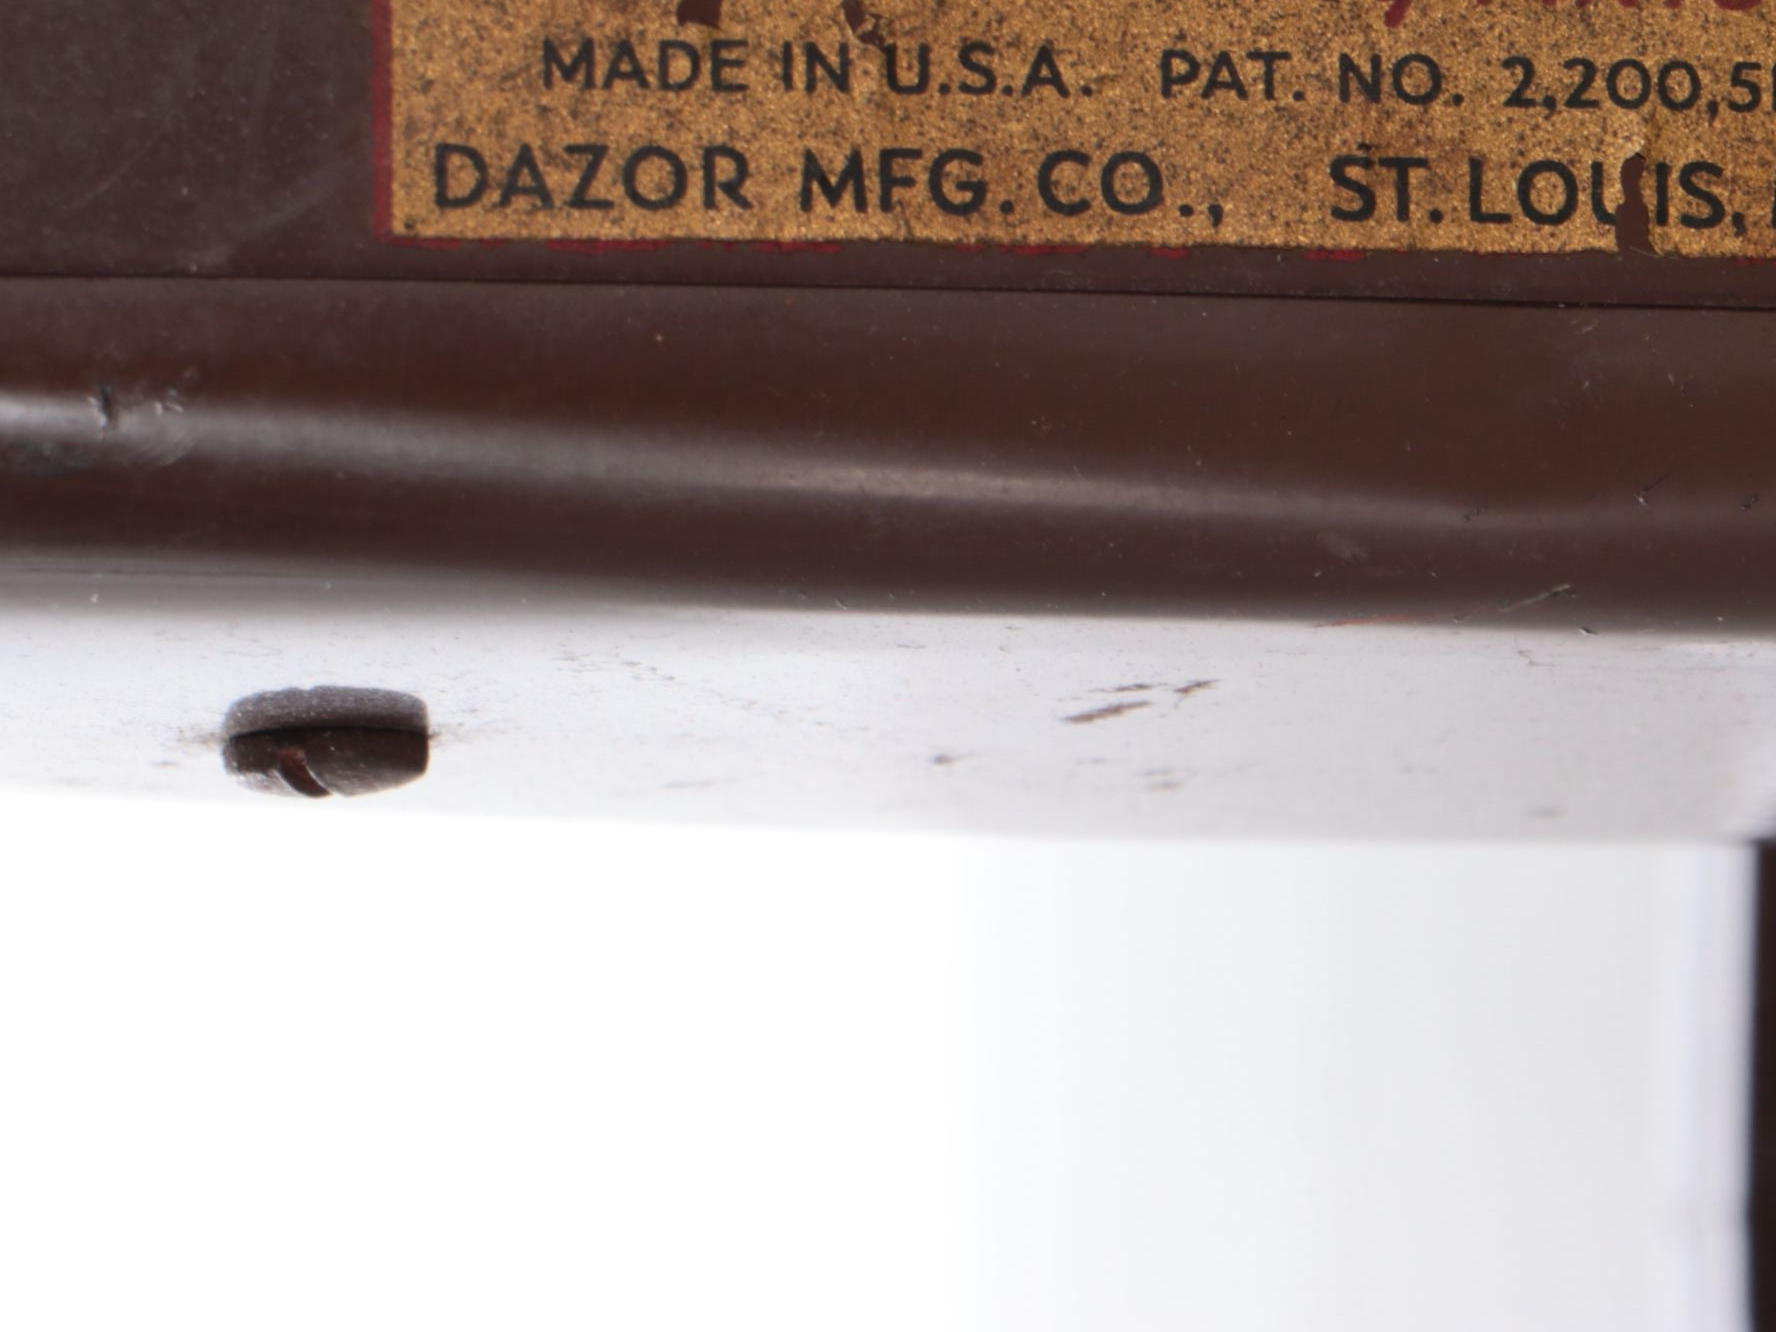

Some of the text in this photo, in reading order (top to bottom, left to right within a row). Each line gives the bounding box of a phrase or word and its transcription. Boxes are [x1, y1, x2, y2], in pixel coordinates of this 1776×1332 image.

[541, 37, 747, 94] MADE
[782, 41, 850, 94] IN
[884, 40, 1095, 99] U.S.A.
[1159, 49, 1305, 104] PAT.
[1339, 54, 1465, 106] NO.
[433, 143, 752, 211] DAZOR
[800, 148, 1016, 215] MFG.
[1037, 150, 1224, 226] CO.,
[1329, 157, 1444, 225] ST.
